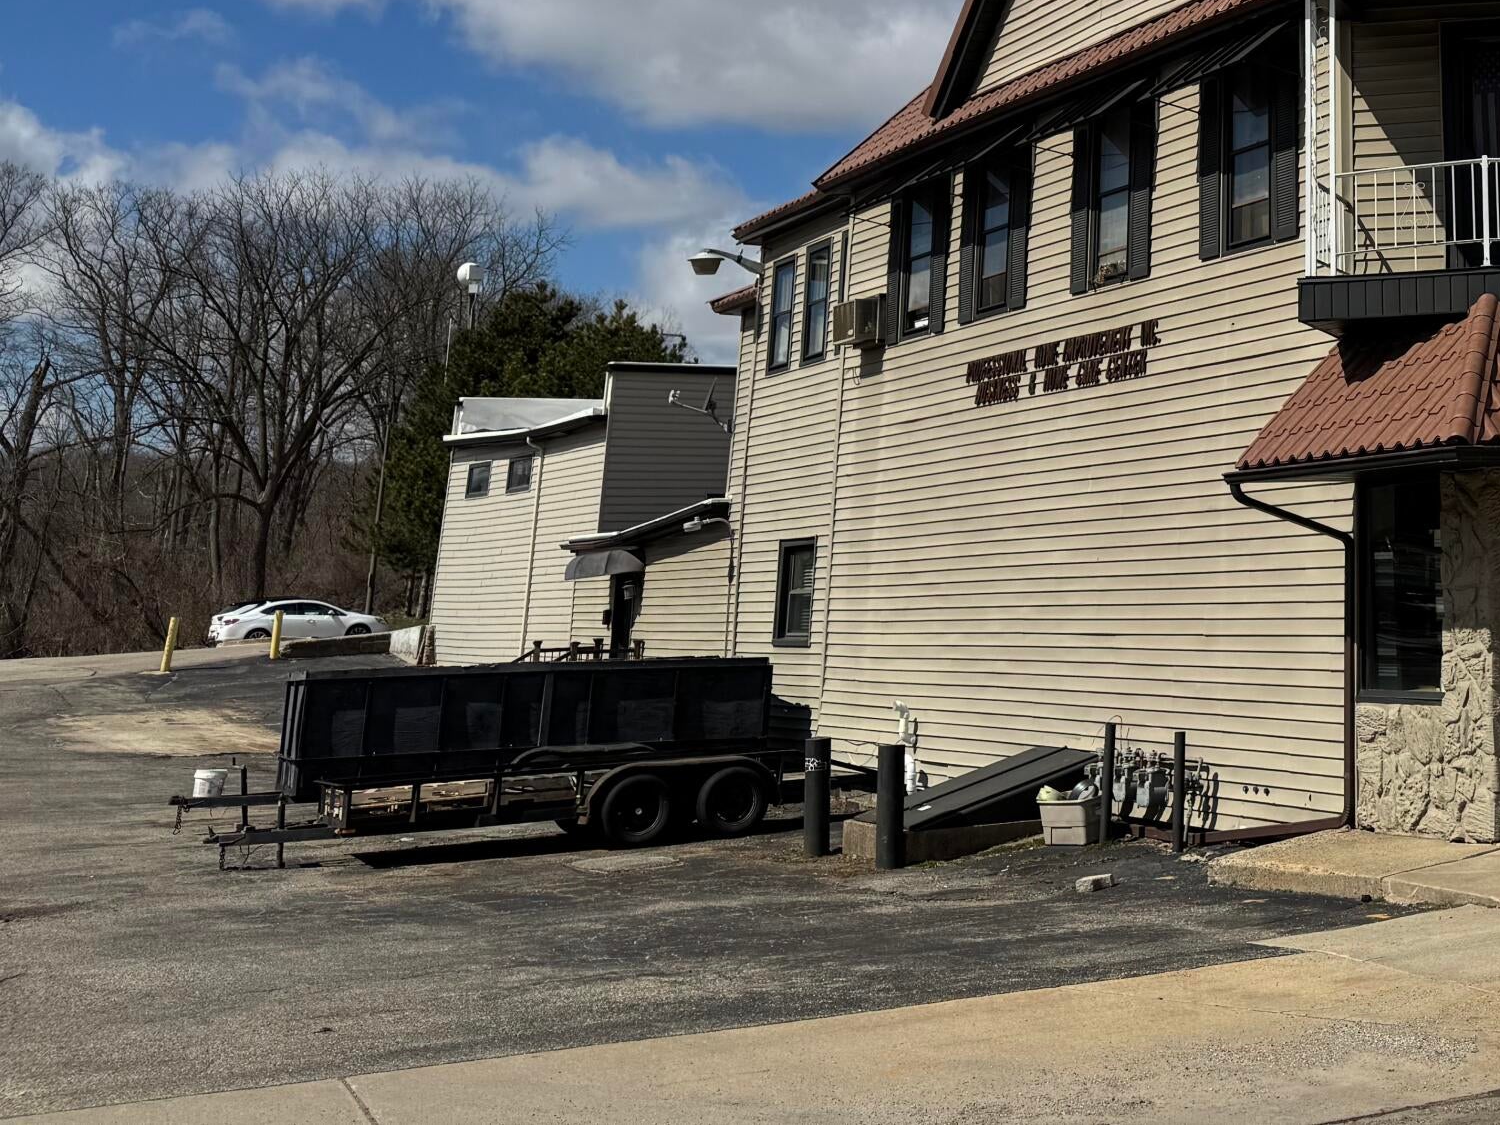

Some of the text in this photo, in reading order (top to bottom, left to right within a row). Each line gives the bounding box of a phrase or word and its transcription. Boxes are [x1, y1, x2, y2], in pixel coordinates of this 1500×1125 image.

[966, 348, 1028, 384] PROFESSIONAL
[1034, 341, 1061, 369] HOME
[1062, 325, 1133, 363] IMPROVEMENT
